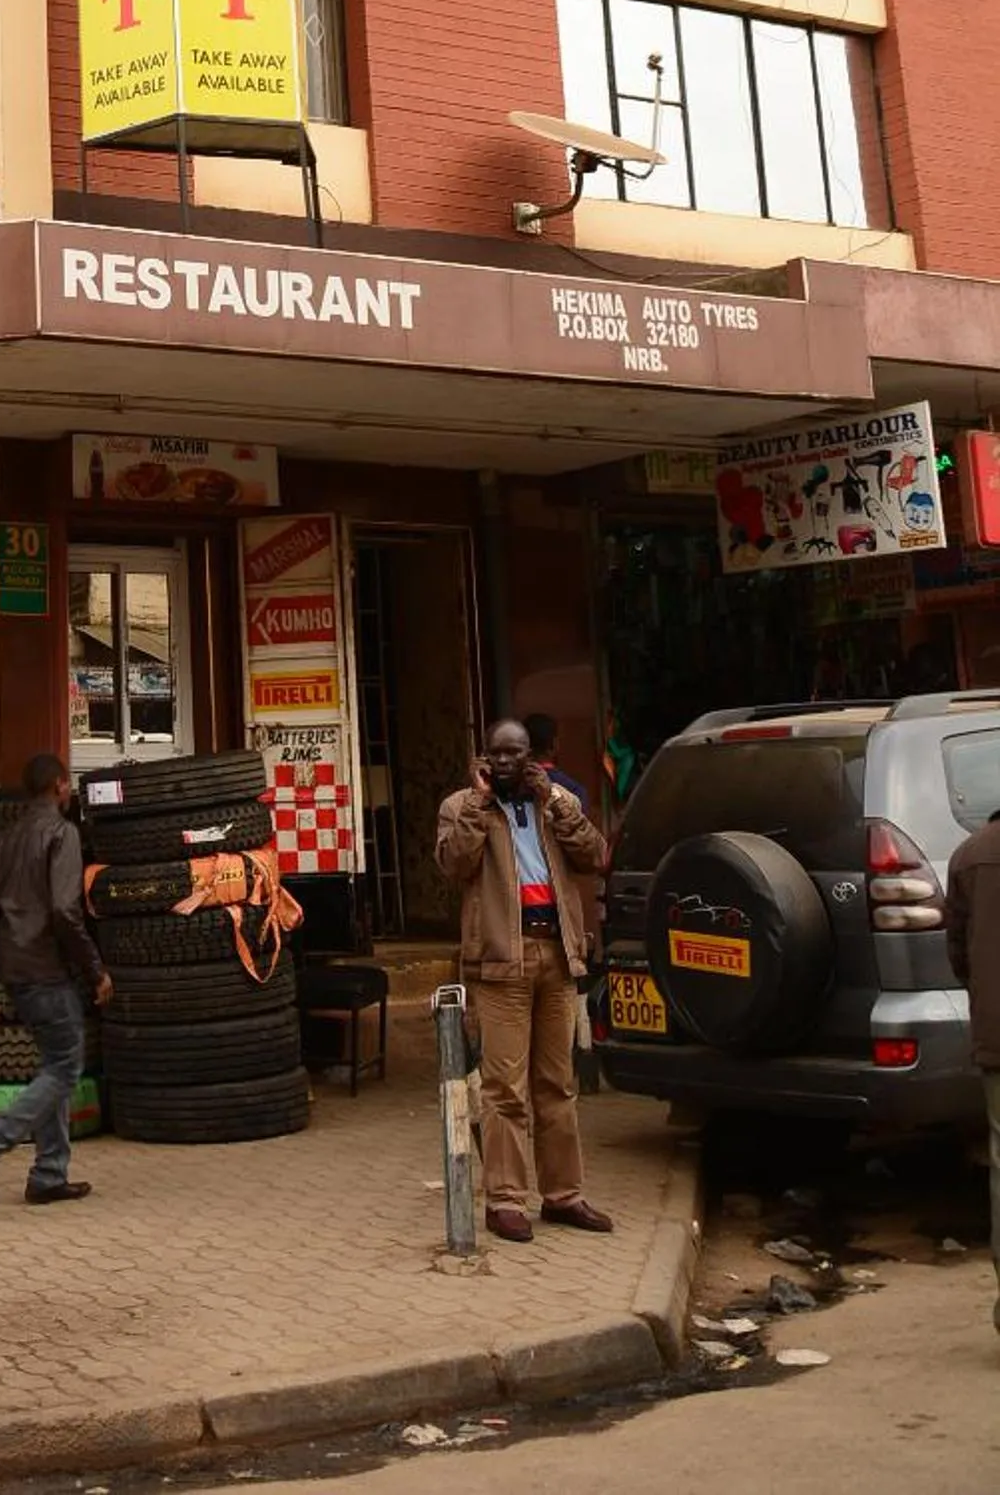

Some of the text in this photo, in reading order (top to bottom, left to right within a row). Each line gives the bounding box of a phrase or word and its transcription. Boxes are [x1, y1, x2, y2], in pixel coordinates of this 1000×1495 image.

[89, 51, 168, 87] TAKE AWAY
[191, 48, 287, 71] TAKE AWAY
[94, 76, 167, 110] AVAILABLE
[197, 73, 285, 95] AVAILABLE
[62, 247, 421, 331] RESTAURANT
[551, 287, 760, 332] HEKIMA AUTO TYRES
[558, 313, 699, 350] P.O.BOX 32180
[623, 346, 669, 374] NRB.
[150, 436, 210, 455] MSAFIRI
[716, 434, 801, 465] BEAUTY
[807, 411, 920, 449] PARLOUR
[4, 526, 40, 557] 30
[250, 523, 329, 579] MARSHAL
[265, 607, 334, 634] KUMHO
[254, 675, 333, 707] PIRELLI
[268, 728, 337, 747] BATTERIES
[281, 746, 322, 762] RIMS
[675, 940, 743, 970] PIRELLI
[611, 975, 648, 1000] KBK
[613, 1000, 663, 1028] 800F
